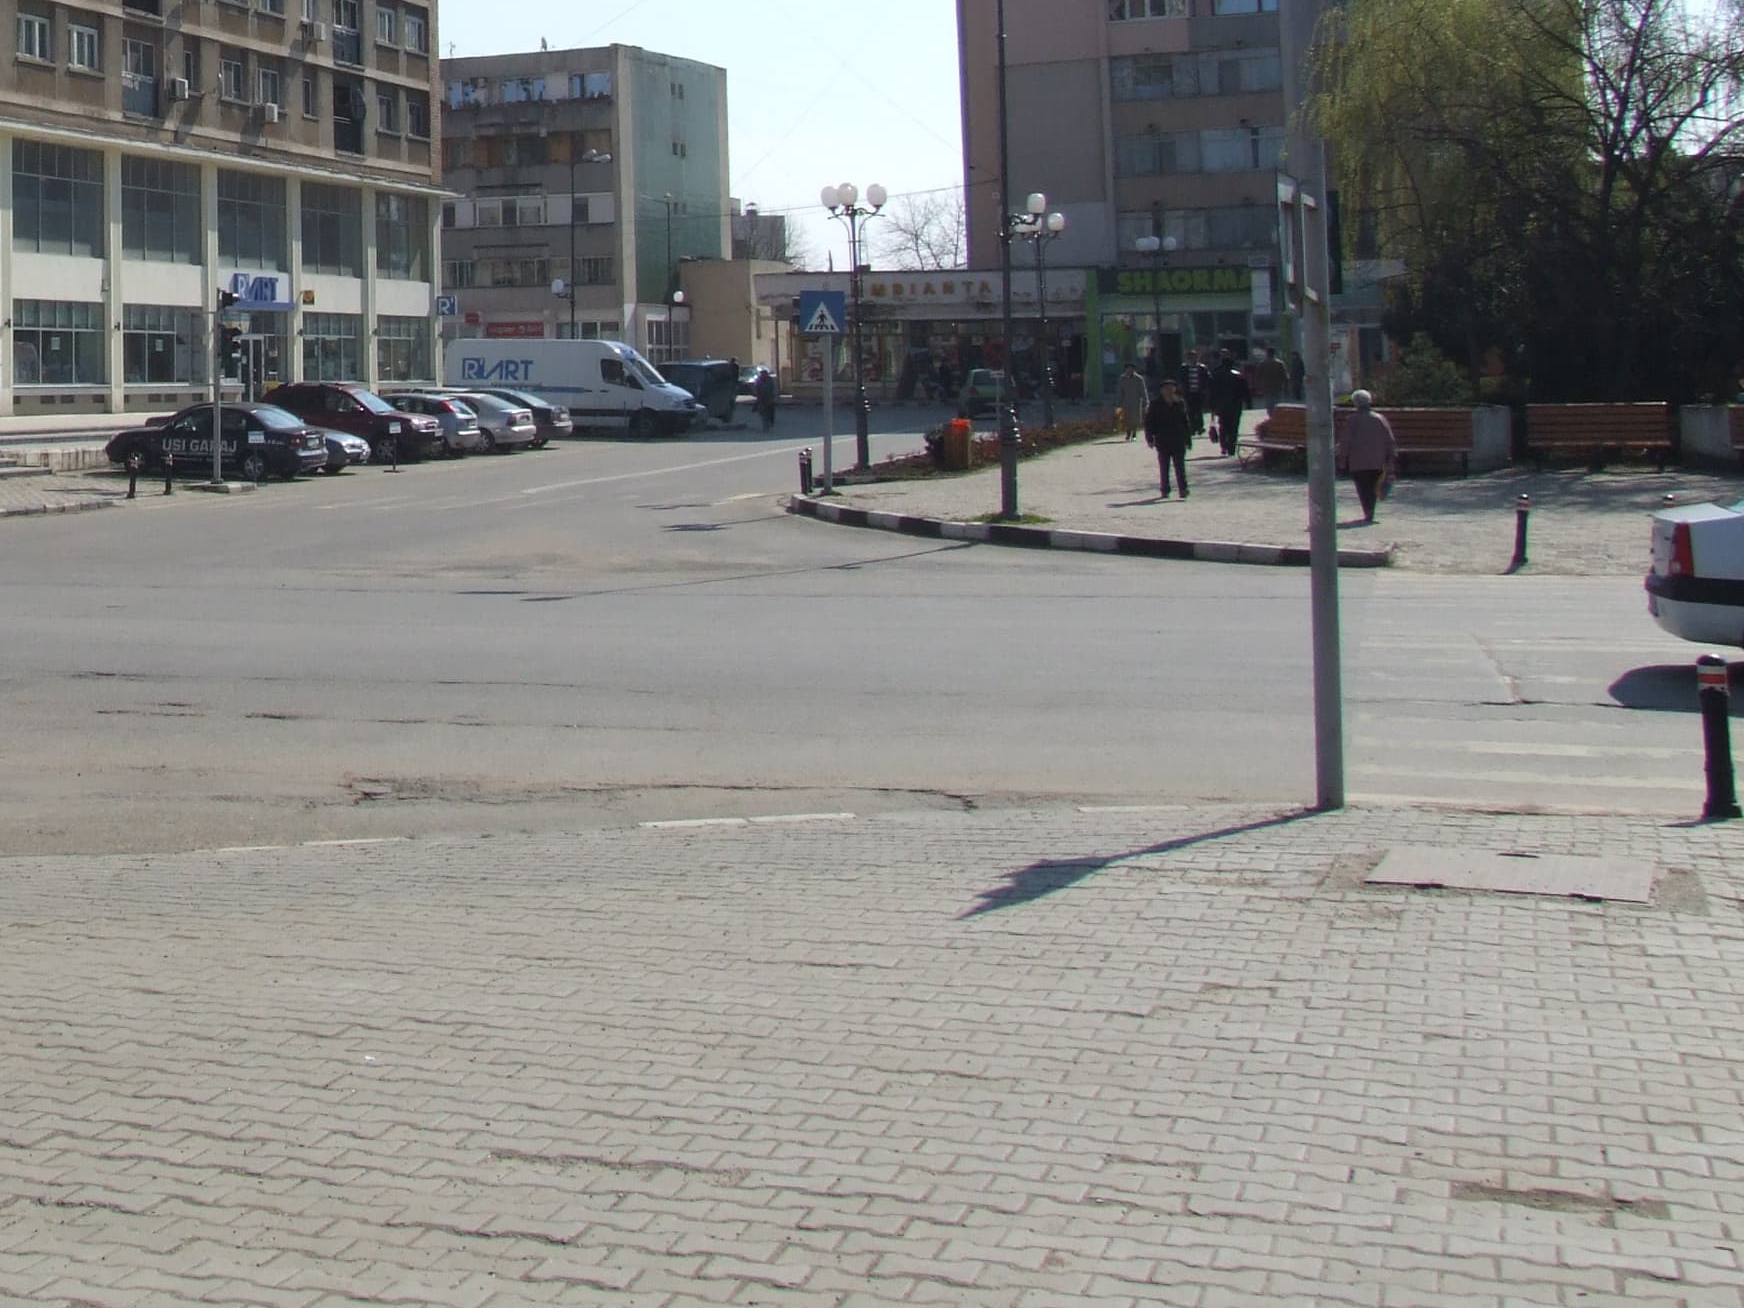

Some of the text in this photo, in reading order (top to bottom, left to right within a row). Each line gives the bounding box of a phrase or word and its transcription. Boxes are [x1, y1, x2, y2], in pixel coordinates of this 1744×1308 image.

[852, 280, 993, 297] MBIANTA
[1117, 270, 1251, 293] SHAORMA
[161, 438, 187, 452] USI
